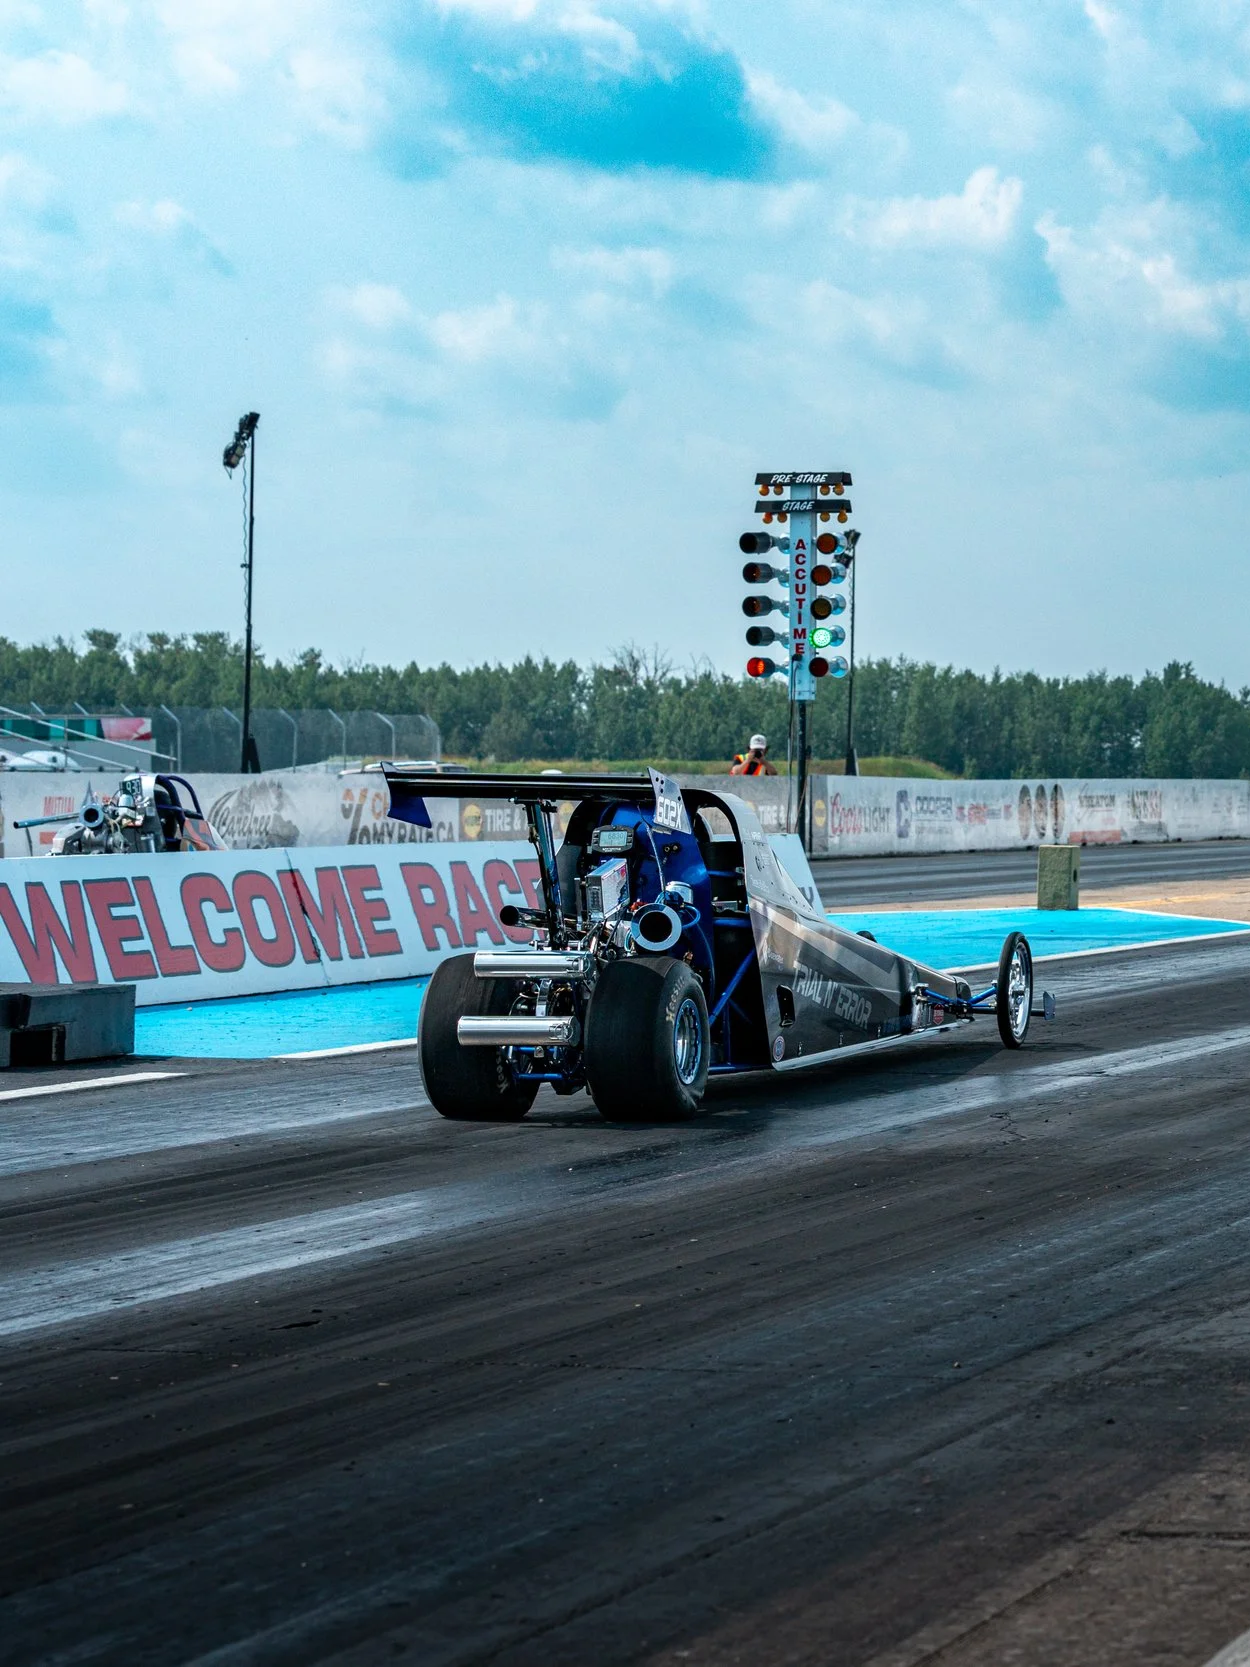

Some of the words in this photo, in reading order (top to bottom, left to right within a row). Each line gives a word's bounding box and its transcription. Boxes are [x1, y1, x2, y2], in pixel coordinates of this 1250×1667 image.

[770, 473, 829, 484] PRE-STAGE
[782, 501, 815, 511] STAGE
[793, 538, 807, 655] ACCUTIME
[485, 808, 512, 832] TIRE
[512, 808, 521, 831] &
[863, 806, 891, 833] LIGHT
[0, 864, 403, 983] WELCOME
[792, 960, 824, 1005] TRIAL
[835, 987, 873, 1030] ERROR
